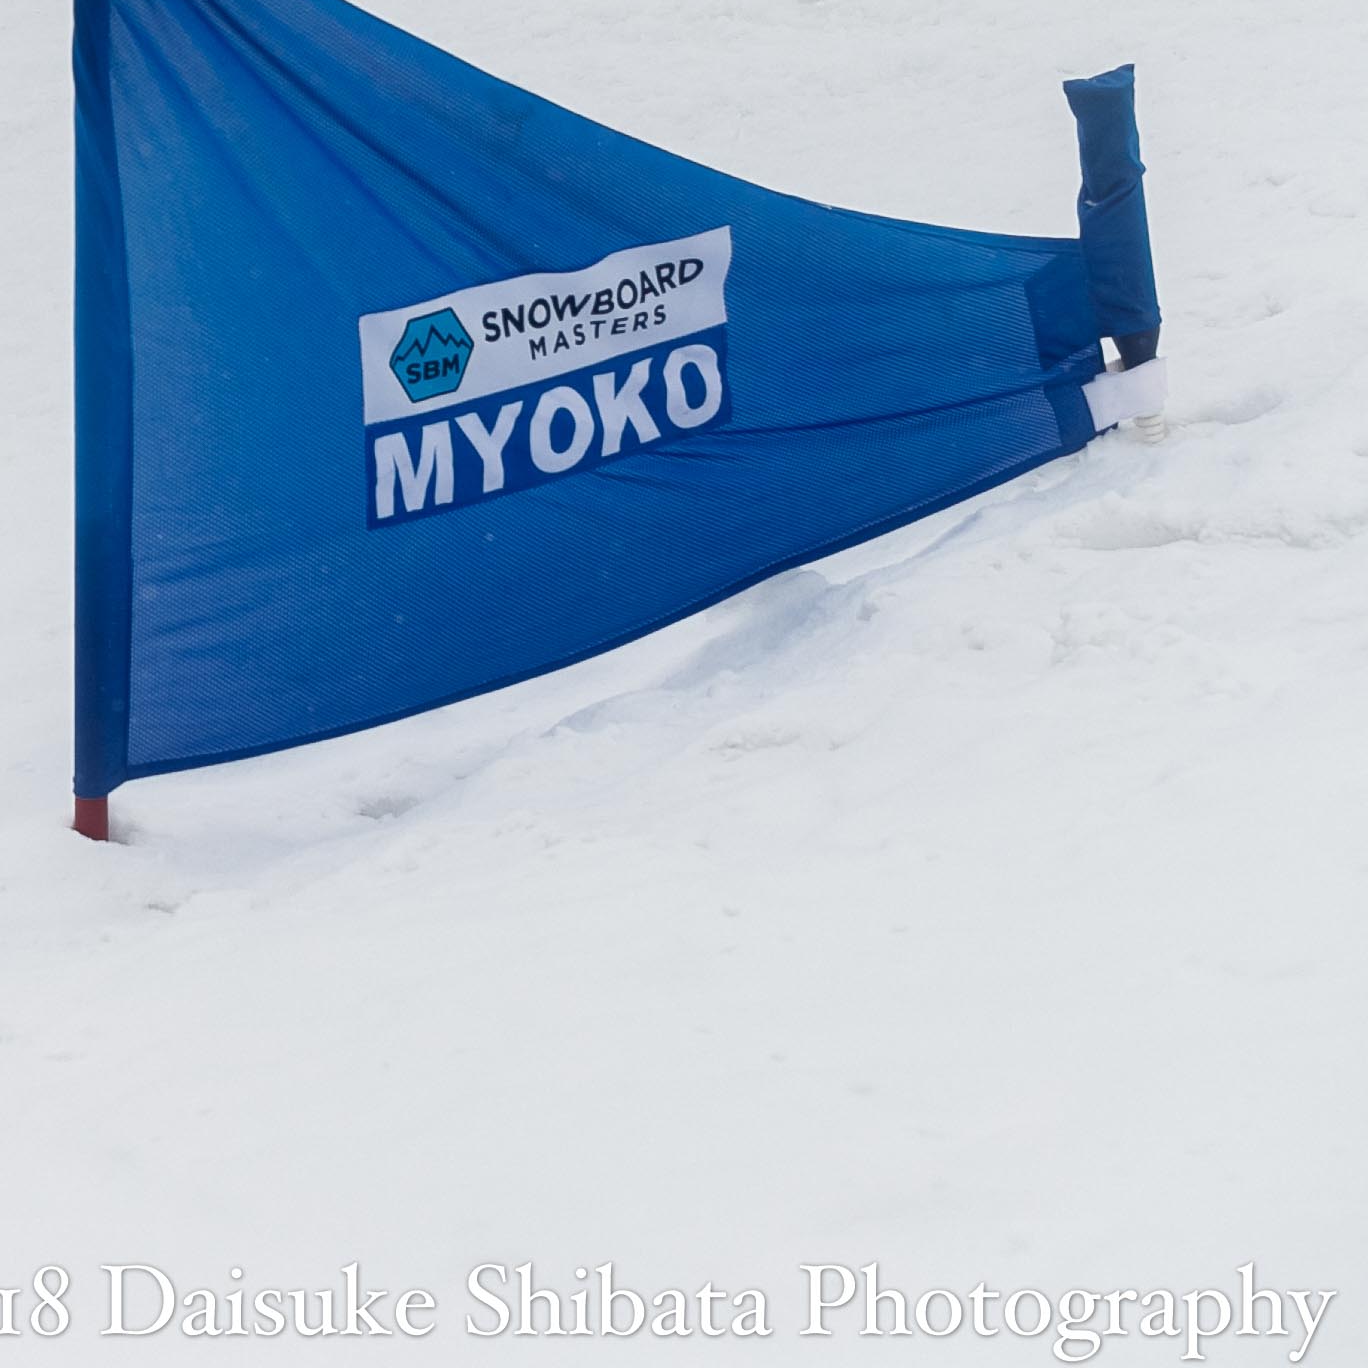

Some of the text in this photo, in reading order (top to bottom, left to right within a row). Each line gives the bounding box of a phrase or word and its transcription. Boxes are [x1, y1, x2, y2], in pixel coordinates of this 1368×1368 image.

[482, 257, 704, 342] SNOWBOARD
[528, 304, 667, 360] MASTERS
[406, 353, 460, 384] SBM
[374, 344, 723, 520] MYOKO
